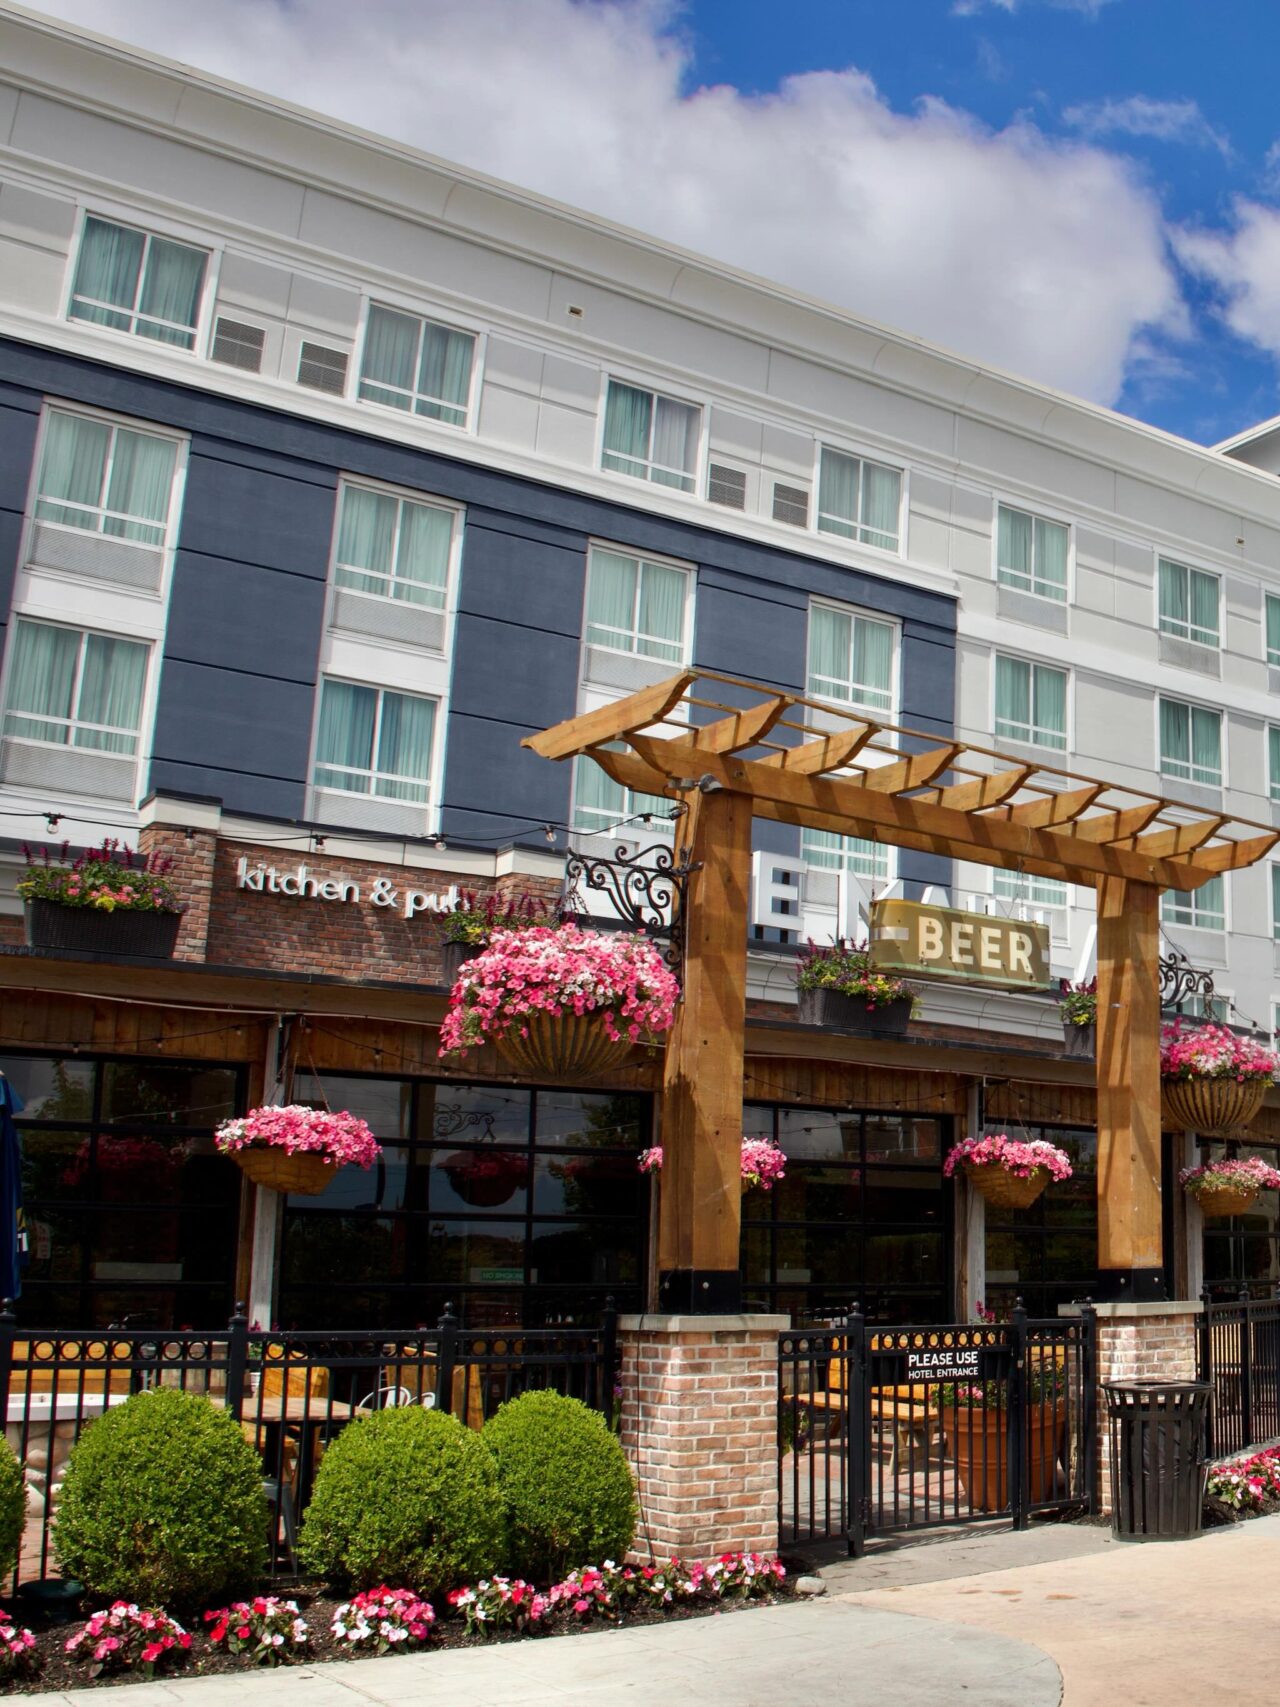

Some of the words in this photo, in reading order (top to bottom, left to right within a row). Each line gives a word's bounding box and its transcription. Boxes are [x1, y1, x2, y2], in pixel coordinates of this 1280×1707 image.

[236, 856, 360, 903] kitchen
[369, 877, 397, 908] &
[404, 884, 471, 919] pub
[918, 915, 1034, 974] BEER
[908, 1353, 953, 1367] PLEASE
[956, 1351, 978, 1364] USE
[908, 1369, 935, 1379] HOTEL
[936, 1367, 978, 1378] ENTRANCE
